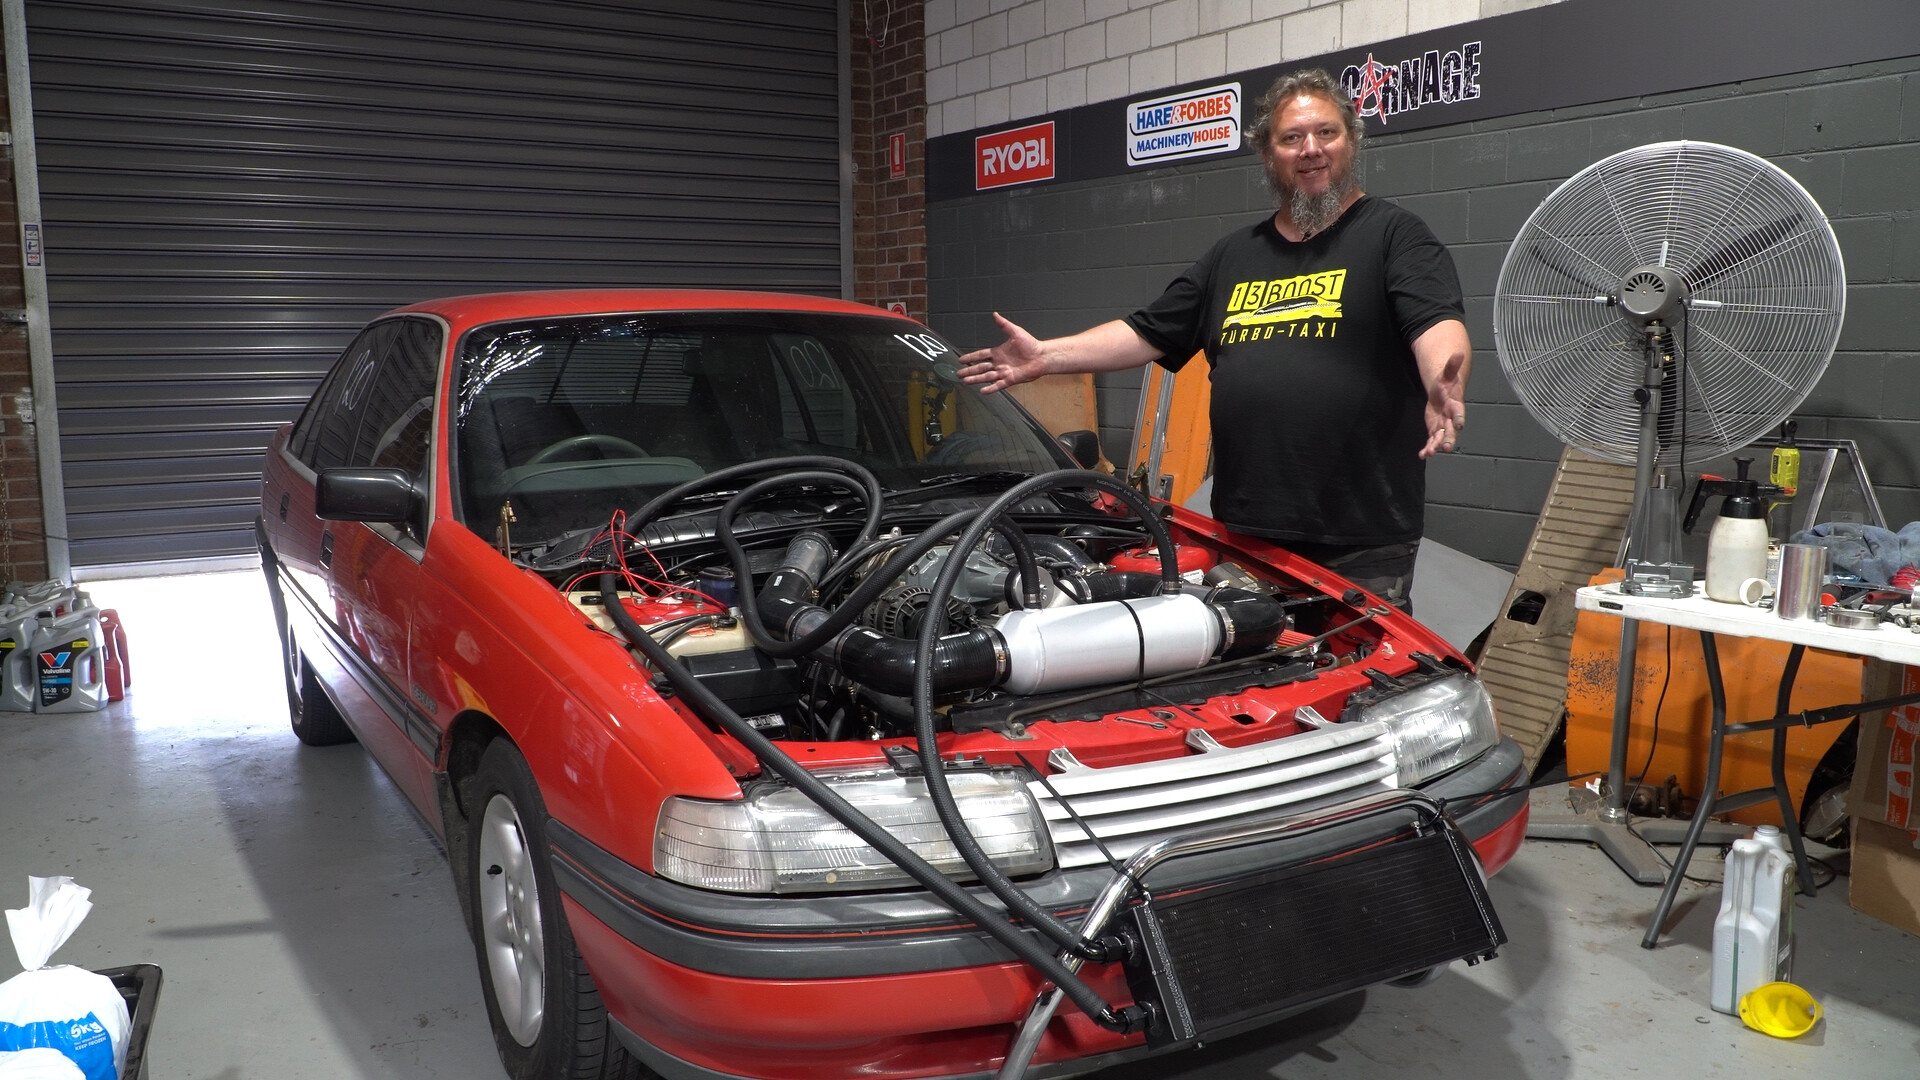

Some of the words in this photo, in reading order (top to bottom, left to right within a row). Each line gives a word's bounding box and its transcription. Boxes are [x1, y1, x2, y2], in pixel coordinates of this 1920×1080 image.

[1340, 41, 1481, 125] CARNAGE
[1136, 94, 1232, 130] HARE&FORBES
[982, 137, 1050, 176] RYOBI
[893, 333, 949, 361] 120
[1220, 322, 1337, 345] TURBO-TAXI
[71, 1022, 103, 1038] 5kg
